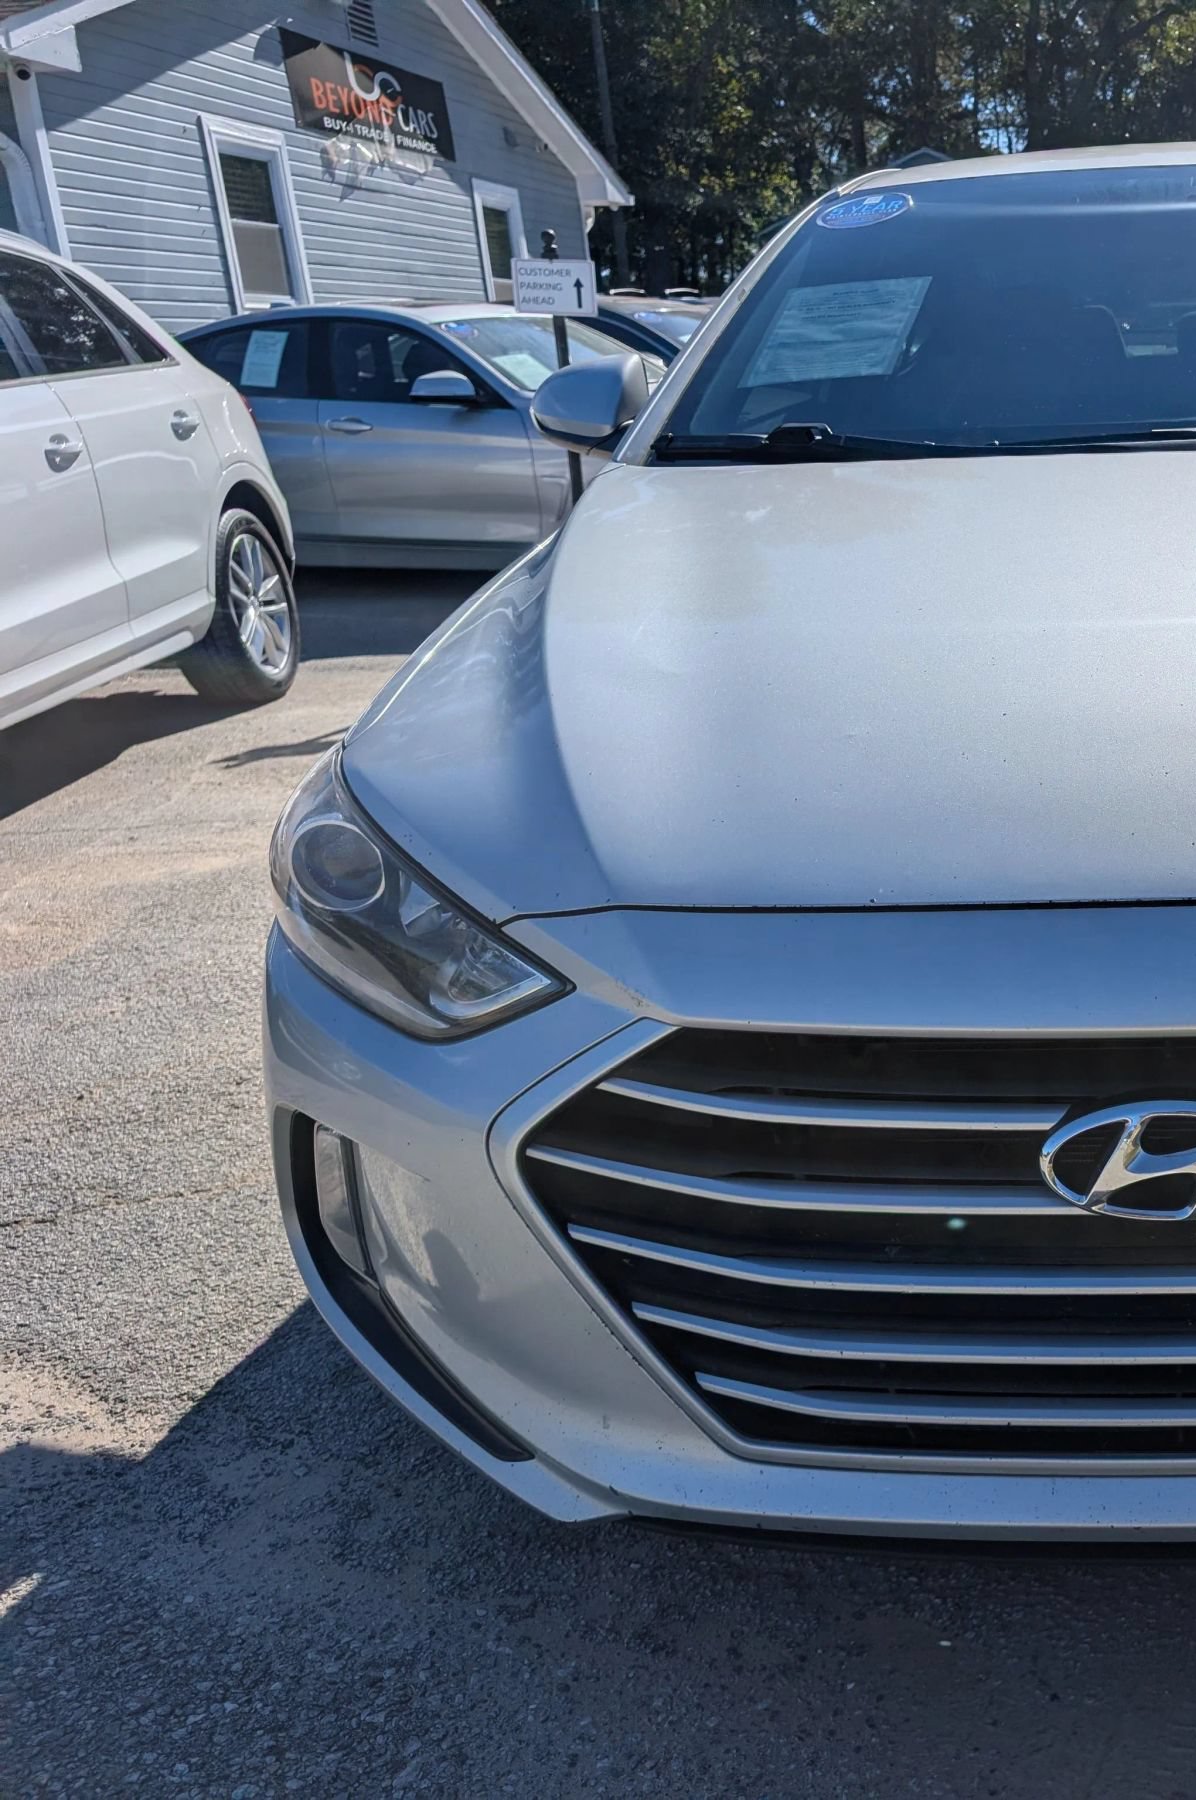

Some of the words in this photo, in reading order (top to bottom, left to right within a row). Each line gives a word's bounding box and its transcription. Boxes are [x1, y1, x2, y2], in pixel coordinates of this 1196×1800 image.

[310, 77, 393, 126] BEYOND
[397, 104, 438, 138] CARS
[323, 116, 348, 132] BUY
[355, 124, 390, 143] TRADE
[397, 135, 438, 154] FINANCE
[518, 267, 572, 278] CUSTOMER
[519, 282, 564, 292] PARKING
[520, 296, 556, 306] AHEAD
